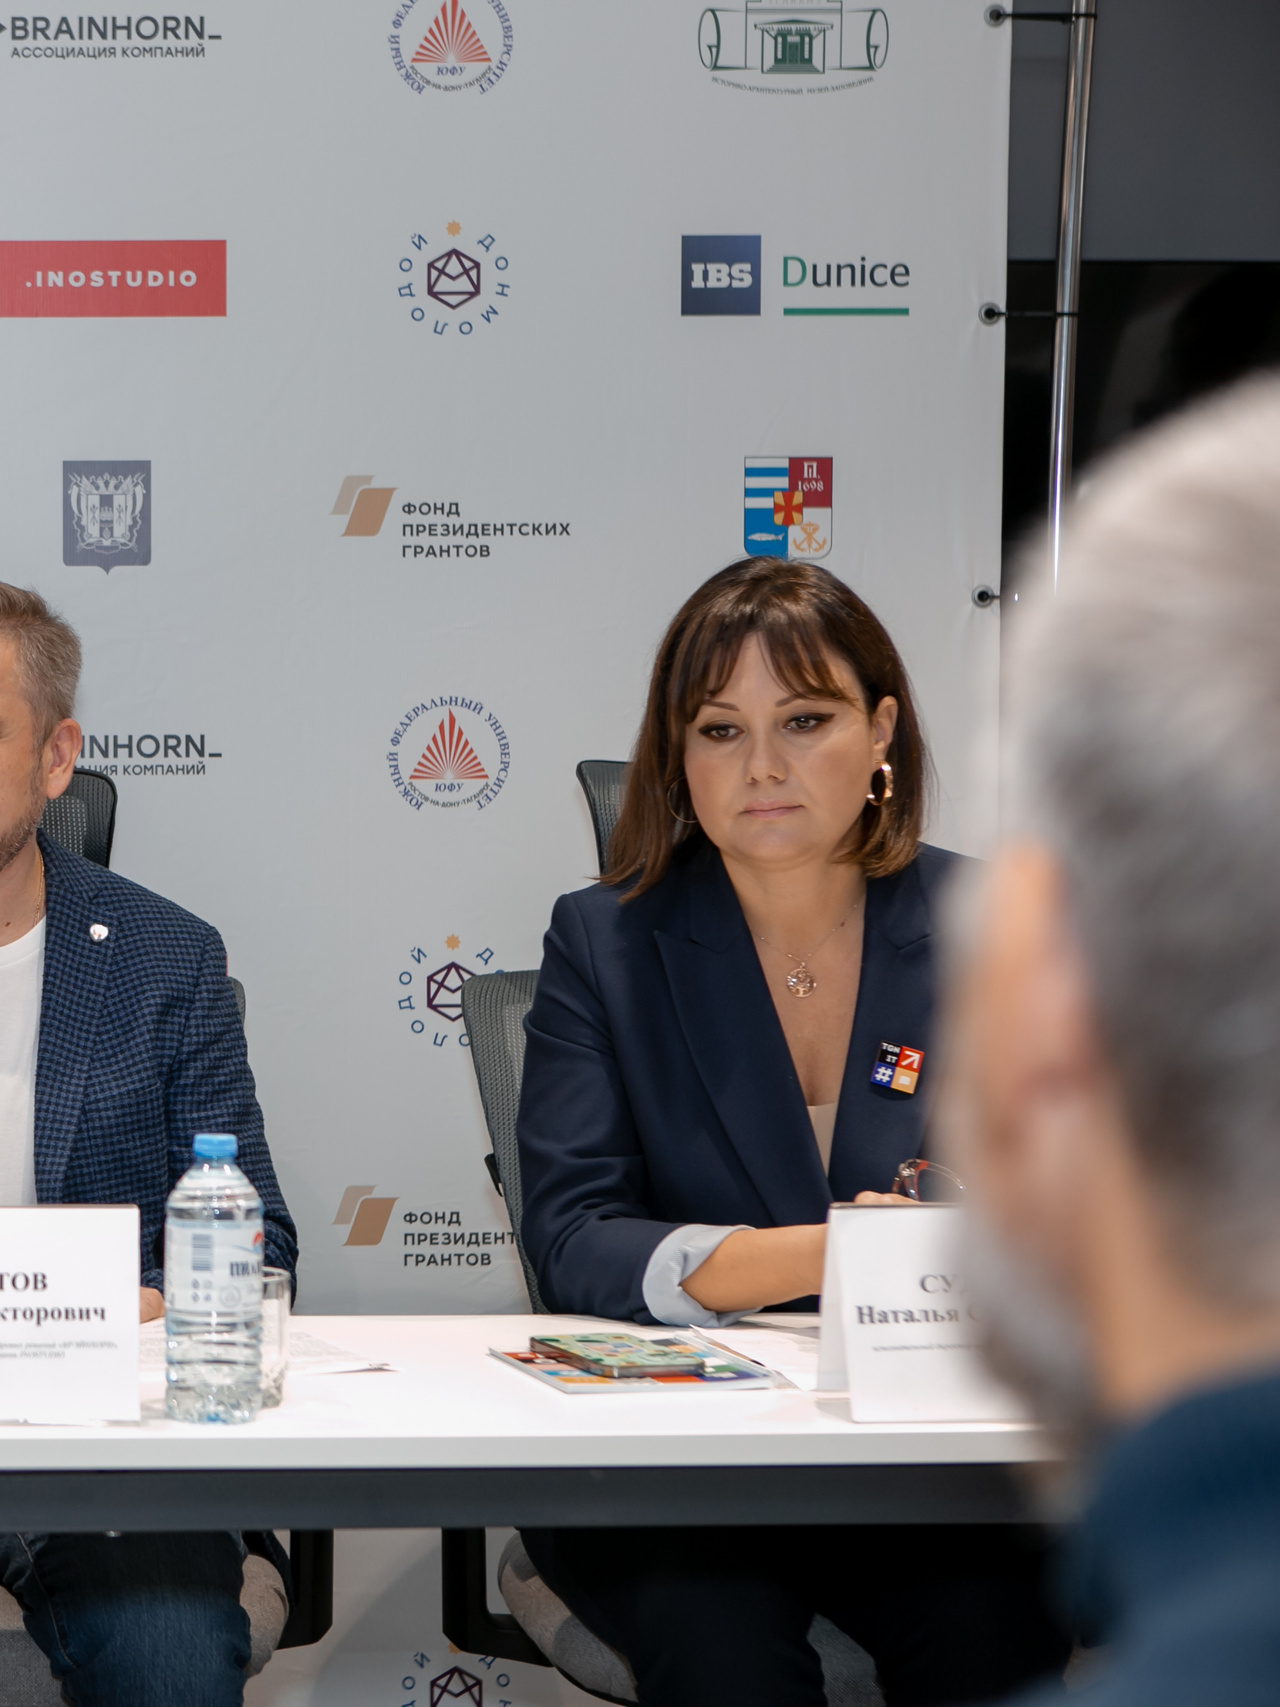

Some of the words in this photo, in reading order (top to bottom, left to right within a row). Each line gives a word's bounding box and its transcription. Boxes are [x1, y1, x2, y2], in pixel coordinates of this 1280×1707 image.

[11, 46, 116, 60] АССОЦИАЦИЯ
[121, 43, 205, 58] КОМПАНИЙ
[387, 33, 426, 95] ЮЖНЫЙ
[479, 0, 514, 95] НИВЕРСИТЕТ
[436, 66, 467, 76] ЮФУ
[691, 262, 753, 288] IBS
[782, 255, 910, 288] Dunice
[798, 480, 824, 492] 1698
[402, 502, 460, 517] ФОНД
[402, 523, 571, 539] ПРЕЗИДЕНТСКИХ
[402, 545, 491, 558] ГРАНТОВ
[390, 695, 484, 747] ФЕДЕРАЛЬНЫЙ
[123, 761, 205, 776] КОМПАНИЙ
[477, 712, 511, 811] УНИВЕРСИТЕТ
[386, 752, 424, 811] ЮЖНЫЙ
[434, 782, 464, 793] ЮФУ
[404, 1211, 461, 1227] ФОНД
[404, 1231, 516, 1247] ПРЕЗИДЕНТ
[404, 1253, 492, 1267] ГРАНТОВ
[856, 1305, 960, 1323] Наталья
